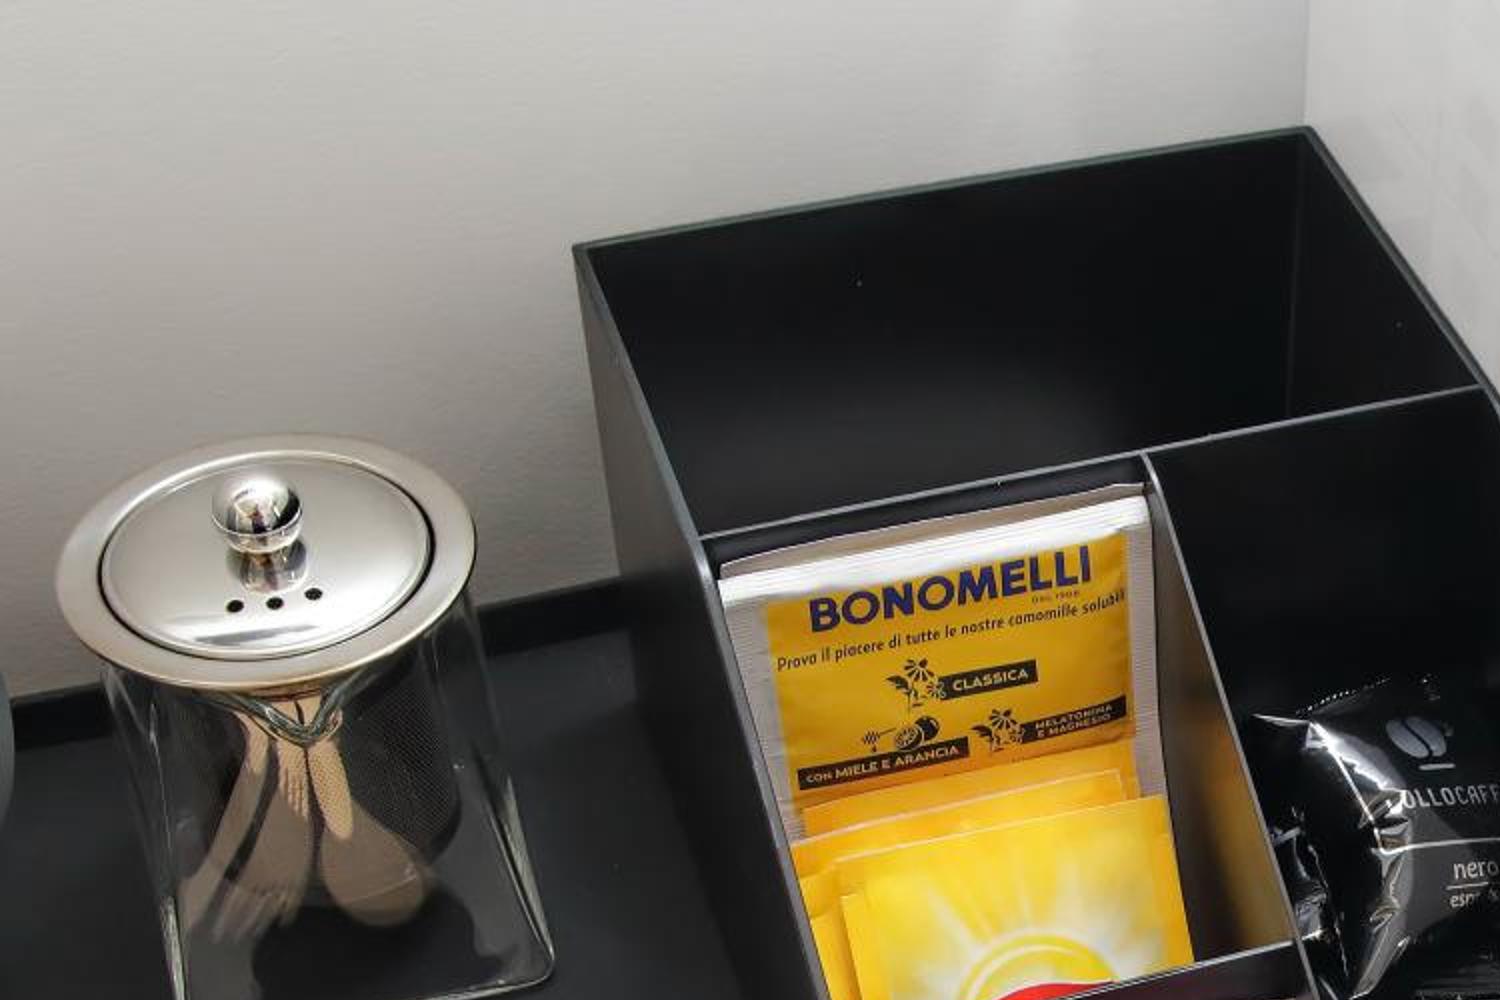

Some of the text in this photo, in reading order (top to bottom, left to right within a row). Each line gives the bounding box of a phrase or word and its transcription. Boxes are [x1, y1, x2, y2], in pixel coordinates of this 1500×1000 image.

[808, 545, 1093, 633] BONOMELLI
[777, 653, 818, 672] Prova
[821, 646, 831, 662] il
[835, 638, 884, 663] piacere
[889, 633, 902, 651] di
[906, 628, 940, 646] tutte
[945, 621, 959, 639] le
[962, 616, 1004, 637] nostre
[1009, 604, 1079, 629] camomille
[952, 668, 1030, 692] CLASSICA
[806, 744, 960, 784] CON MIELE E ARANCIA
[1452, 860, 1500, 881] nero
